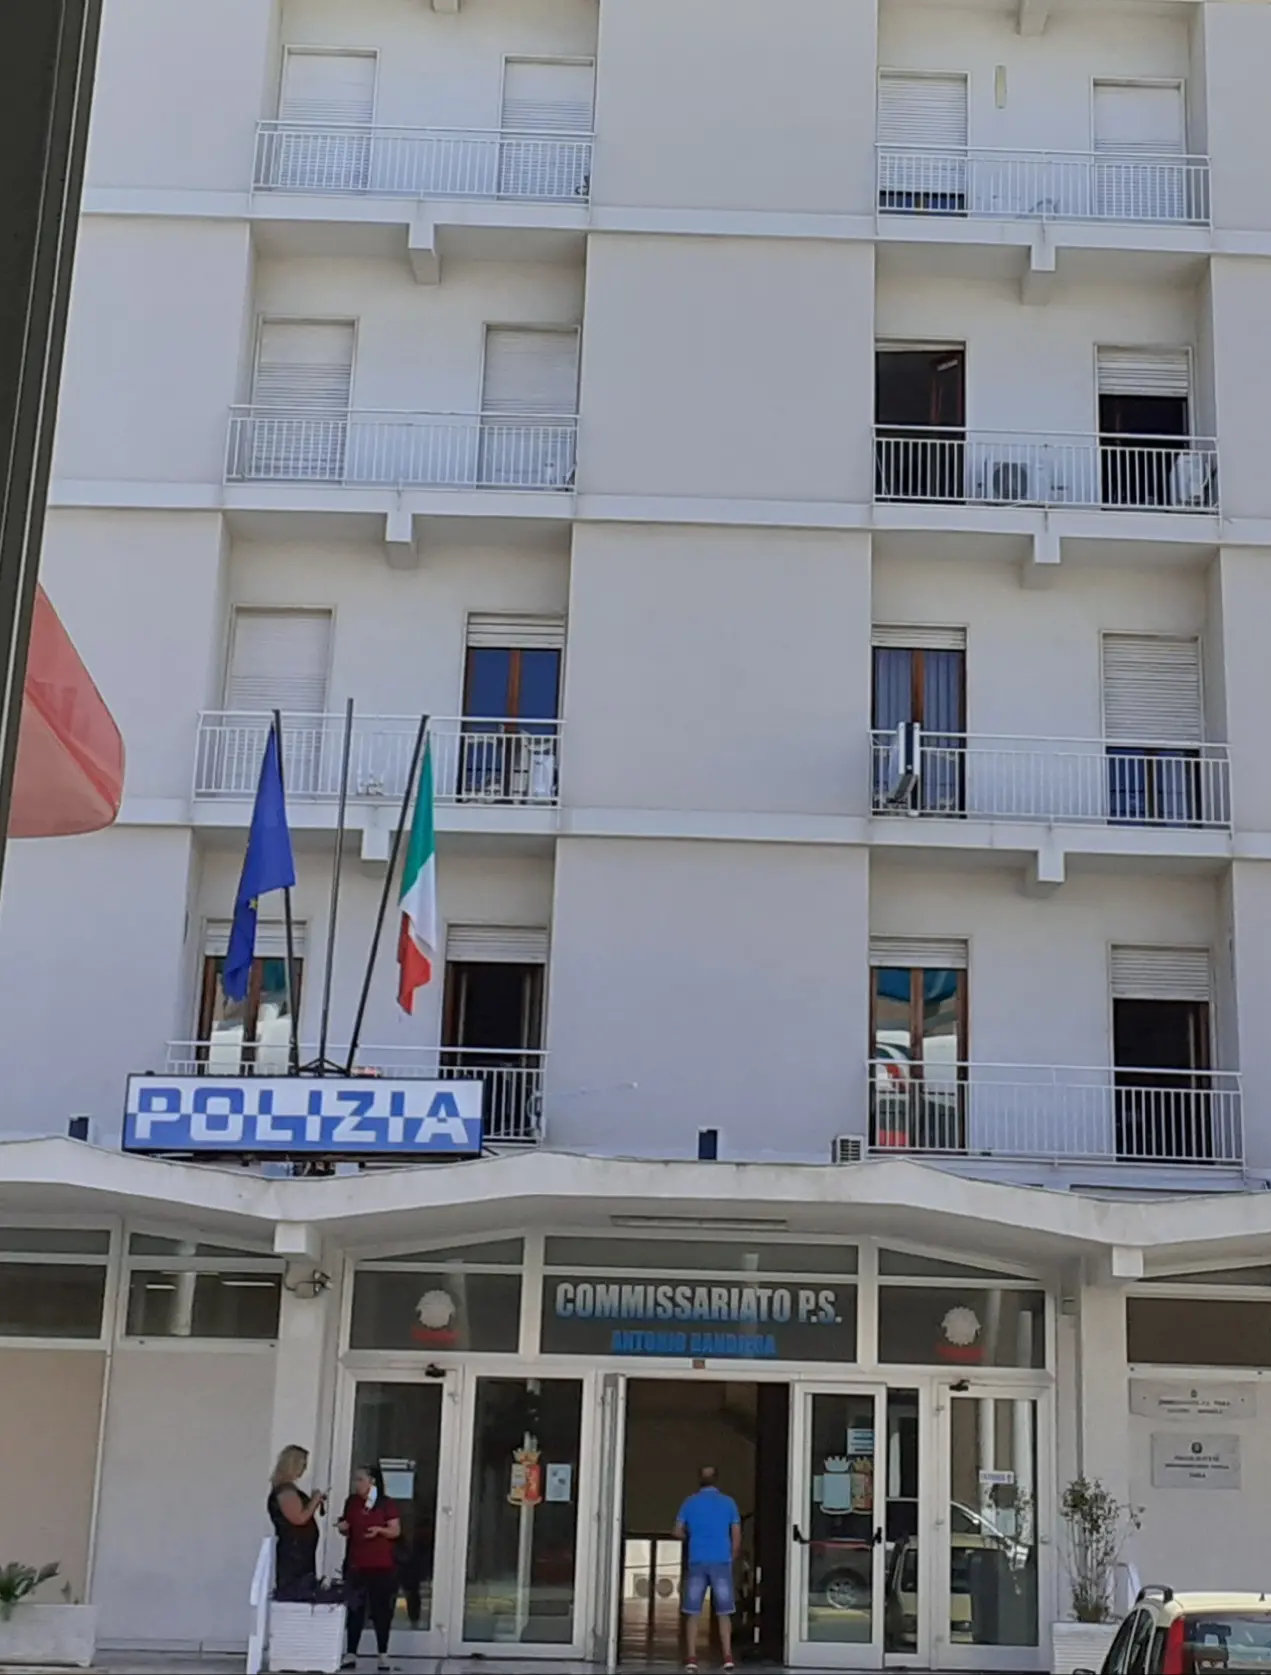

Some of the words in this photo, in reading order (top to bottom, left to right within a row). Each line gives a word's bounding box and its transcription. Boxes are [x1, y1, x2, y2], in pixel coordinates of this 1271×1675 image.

[134, 1087, 469, 1144] POLIZIA
[556, 1282, 792, 1323] COMMISSARIATO
[799, 1289, 843, 1324] P.S.
